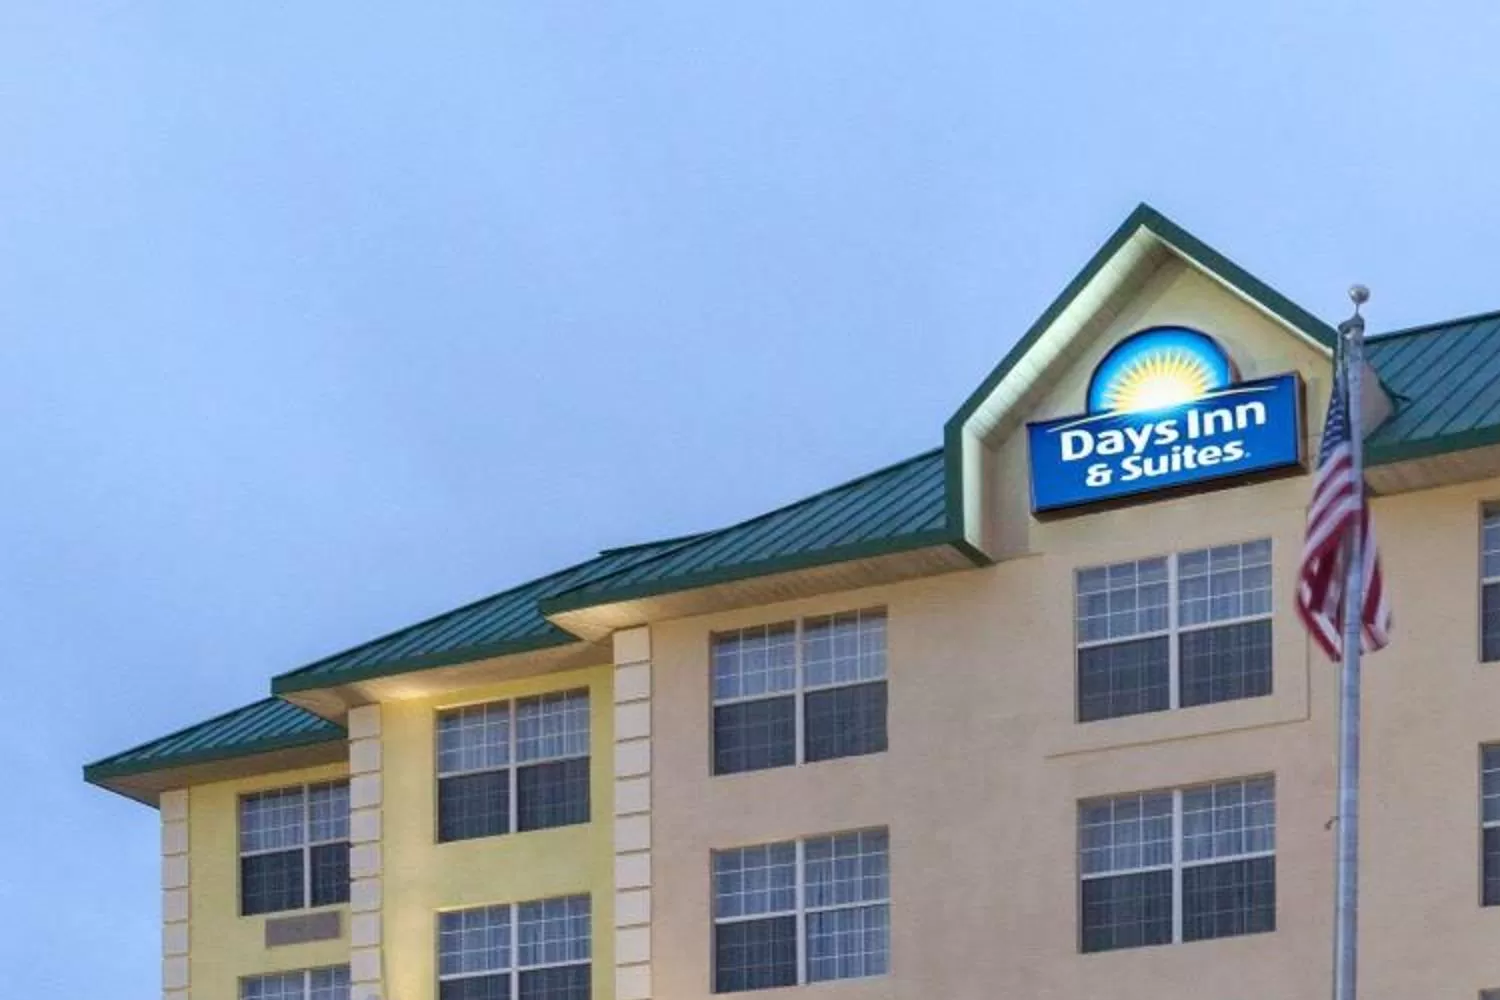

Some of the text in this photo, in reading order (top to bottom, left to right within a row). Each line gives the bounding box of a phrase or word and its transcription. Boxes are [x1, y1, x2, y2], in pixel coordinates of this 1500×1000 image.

[1060, 400, 1267, 462] Days Inn
[1085, 440, 1244, 487] & Suites
